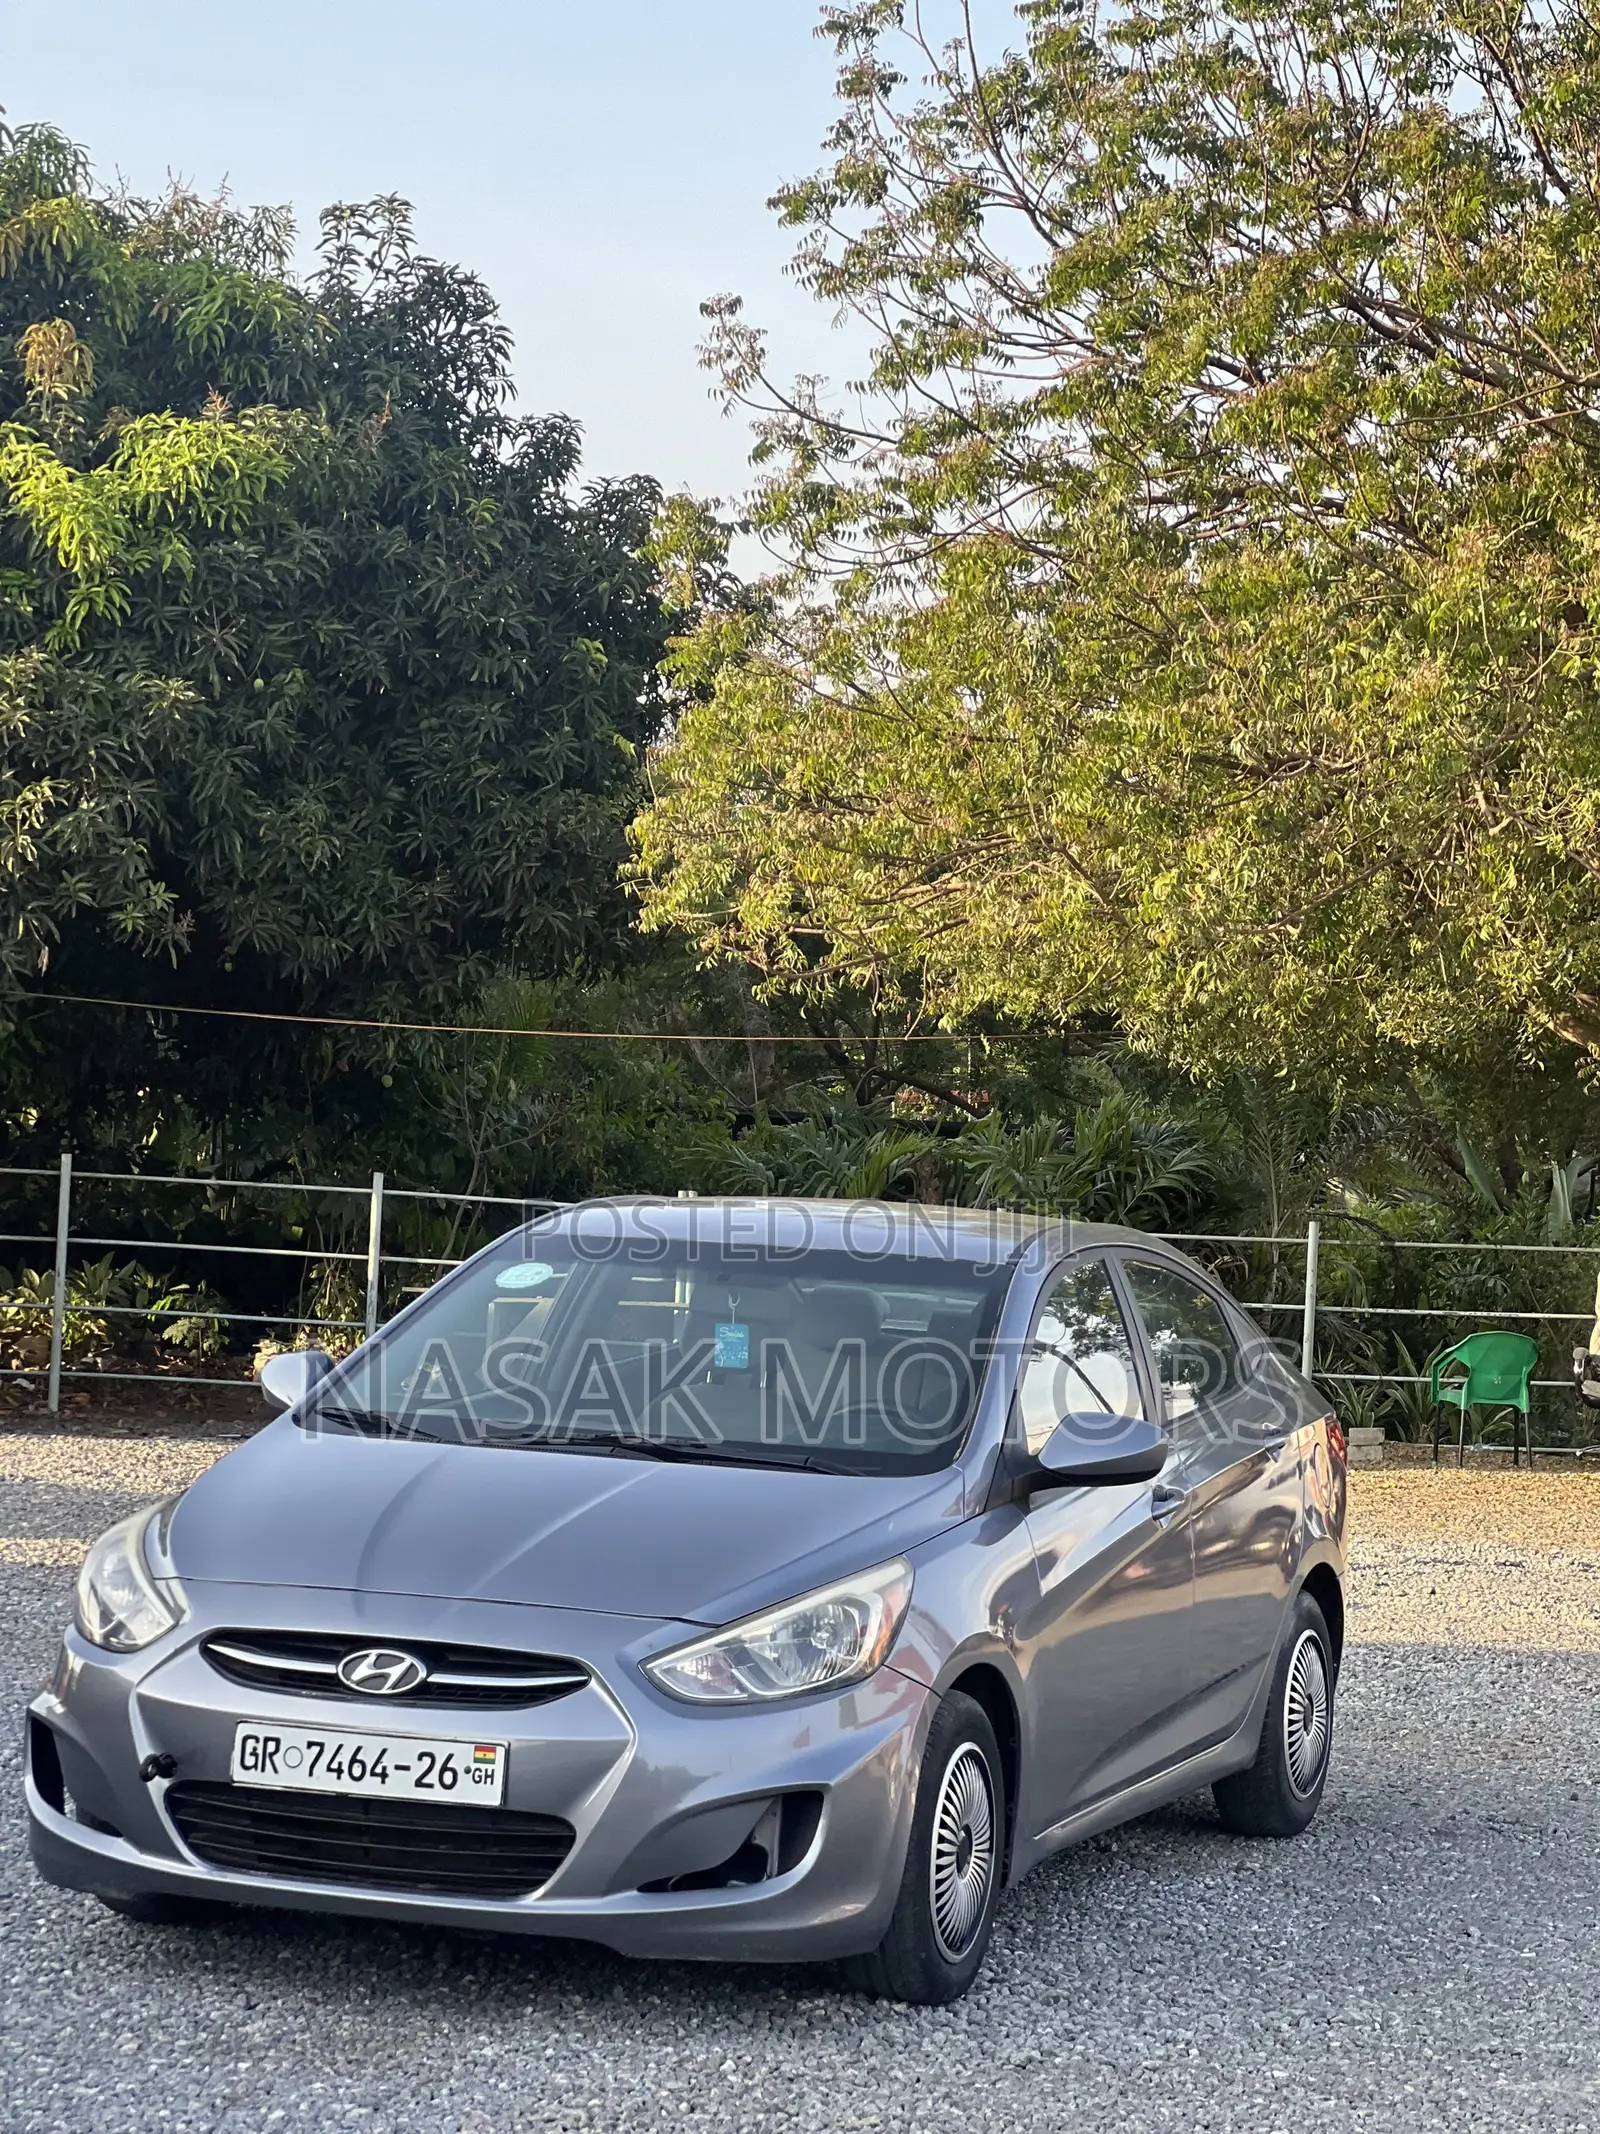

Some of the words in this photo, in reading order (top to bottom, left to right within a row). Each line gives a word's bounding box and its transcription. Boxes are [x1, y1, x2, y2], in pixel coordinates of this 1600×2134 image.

[240, 1733, 282, 1774] GR
[306, 1740, 459, 1790] 7464-26
[471, 1766, 495, 1786] GH
